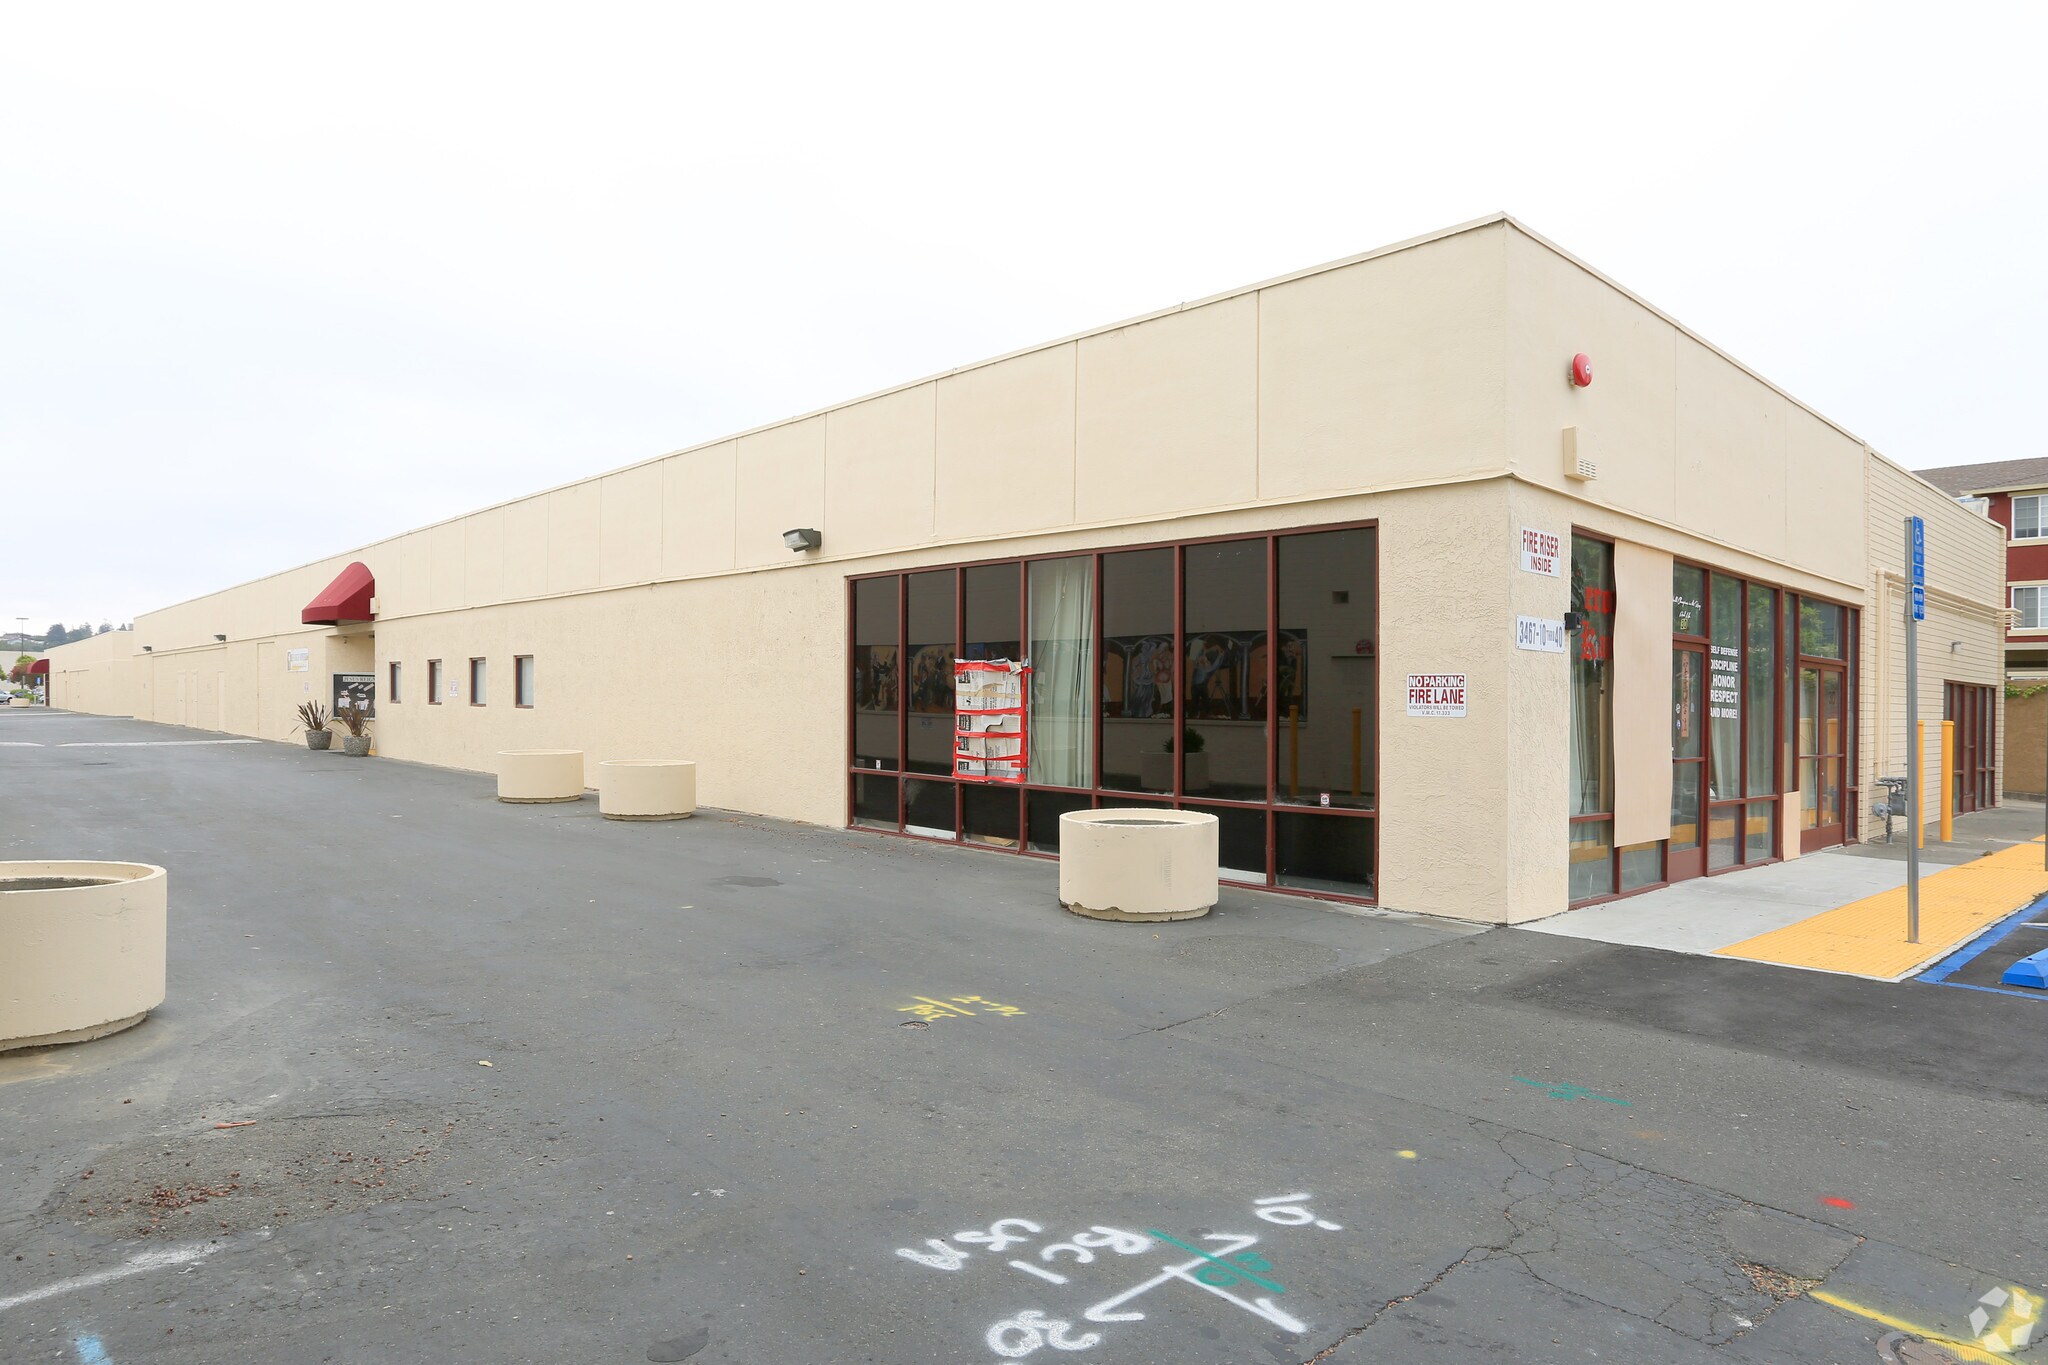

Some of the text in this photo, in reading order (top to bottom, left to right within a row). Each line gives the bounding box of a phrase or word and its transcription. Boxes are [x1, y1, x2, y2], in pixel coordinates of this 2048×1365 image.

[1523, 530, 1559, 558] FIRE RISER
[1530, 556, 1552, 573] INSIDE
[1519, 621, 1546, 646] 3467-10
[1555, 626, 1563, 648] 40
[1720, 647, 1738, 657] DEFENSE
[1409, 676, 1464, 687] NO PARKING
[1712, 674, 1736, 689] HONOR
[1409, 689, 1464, 704] FIRE LANE
[1710, 689, 1738, 704] RESPECT
